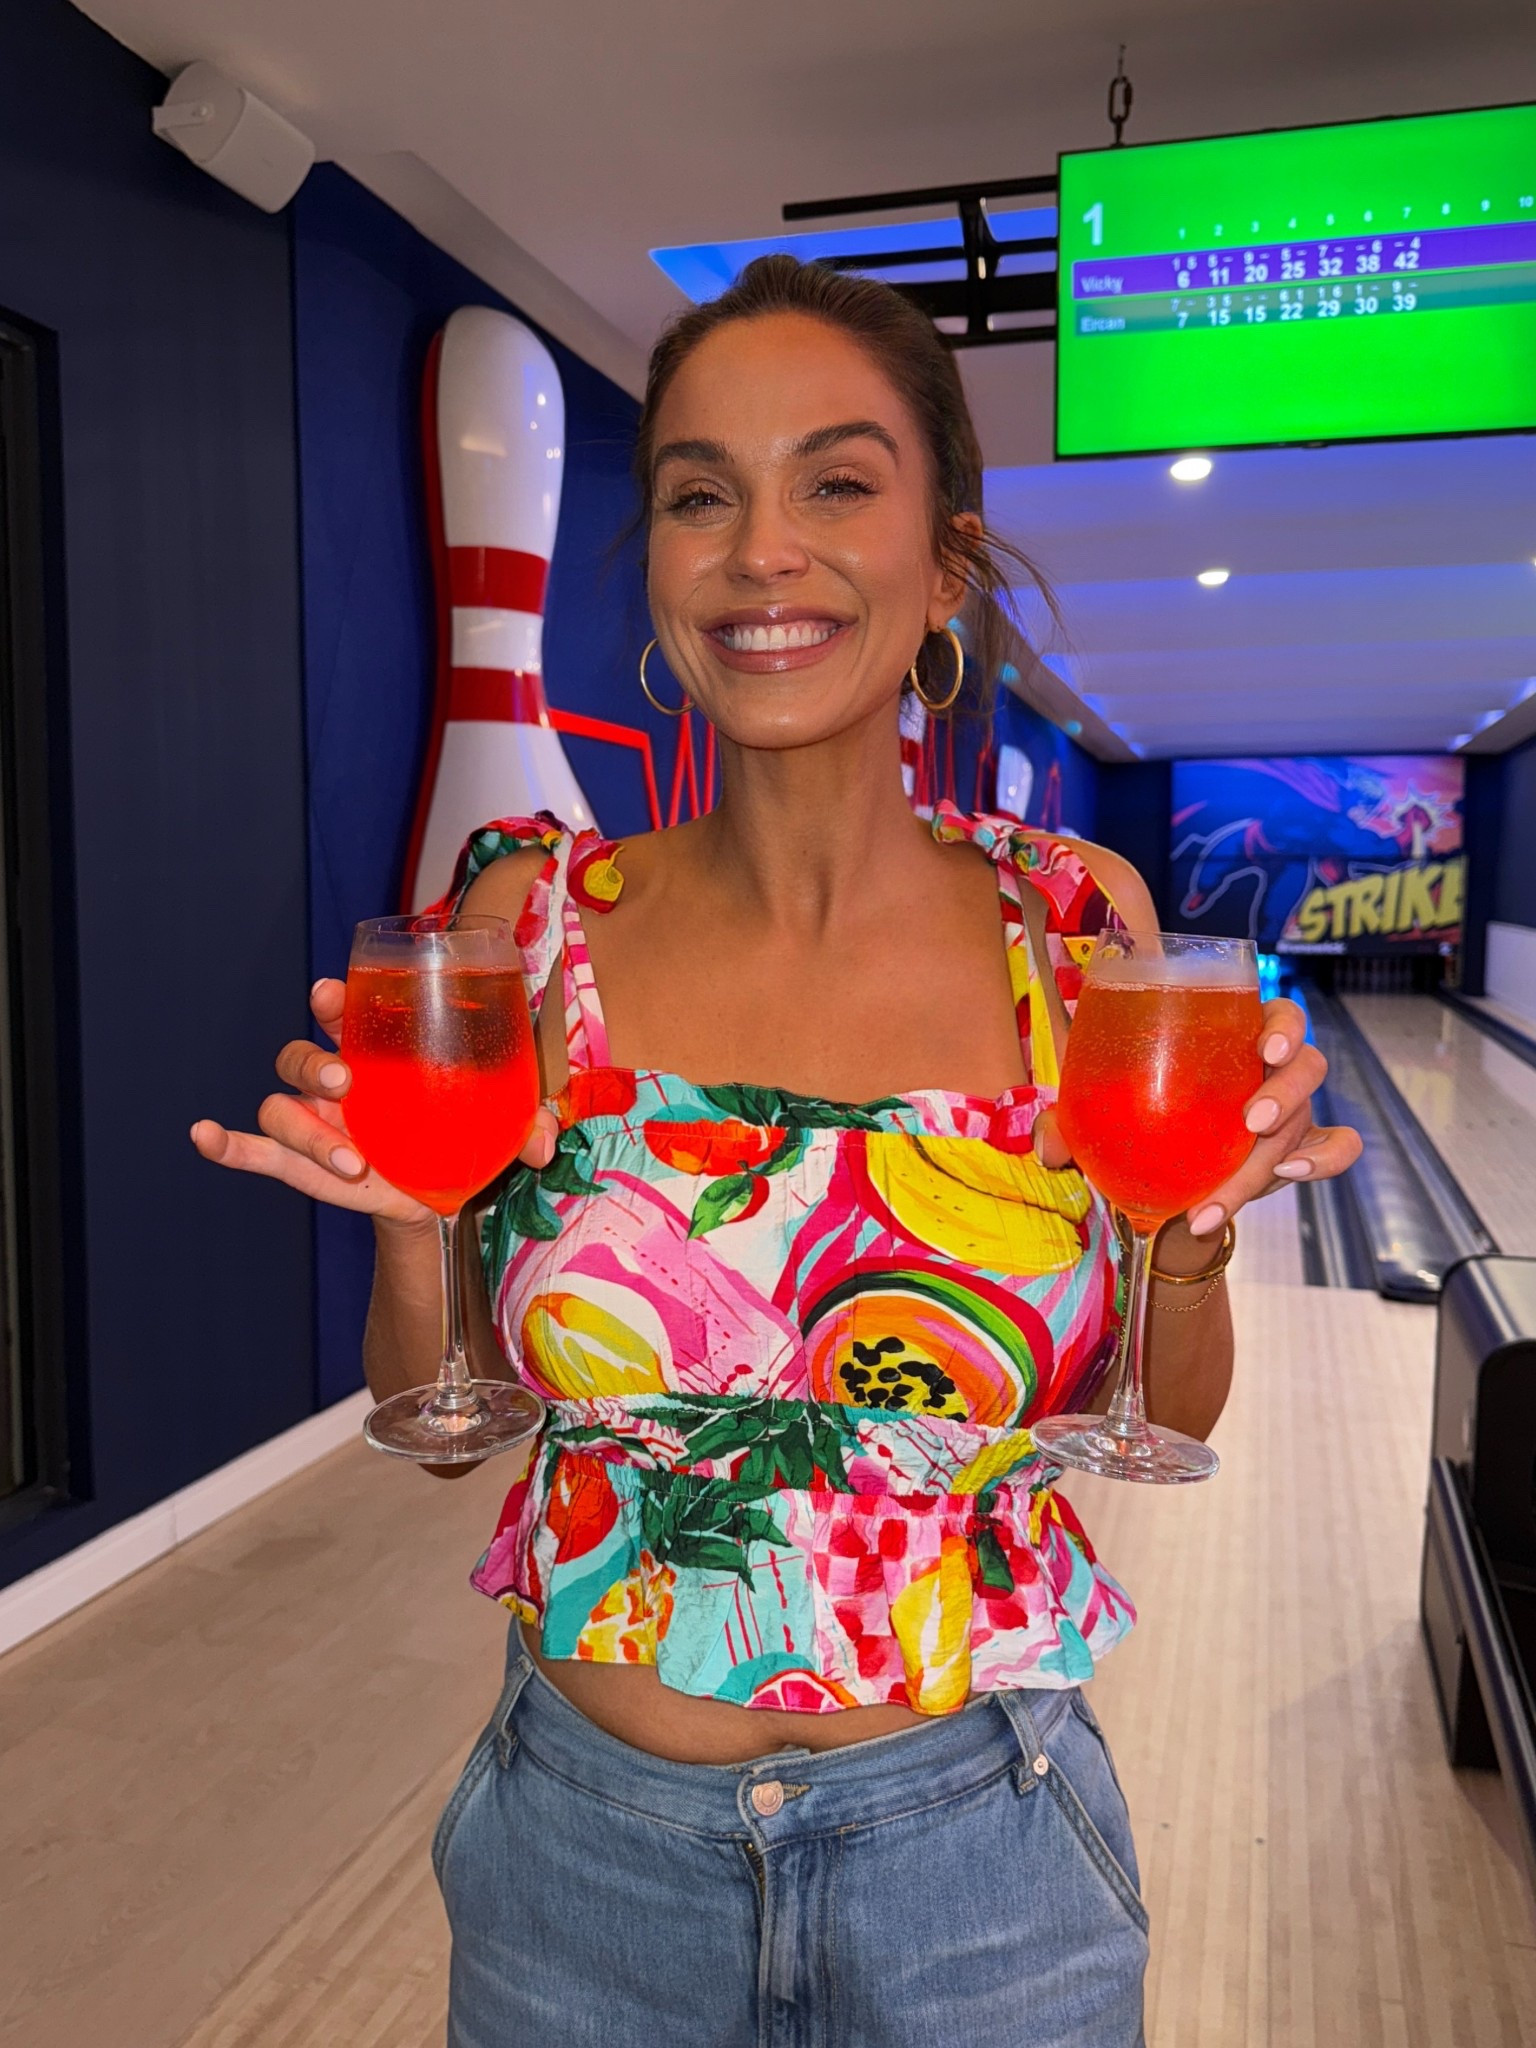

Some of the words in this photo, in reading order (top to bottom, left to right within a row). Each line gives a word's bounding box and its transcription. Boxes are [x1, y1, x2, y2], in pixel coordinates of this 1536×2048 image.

[1083, 201, 1103, 246] 1
[1179, 228, 1186, 240] 1
[1214, 224, 1223, 236] 2
[1251, 221, 1259, 232] 3
[1288, 217, 1296, 228] 4
[1403, 206, 1411, 218] 7
[1442, 203, 1450, 215] 8
[1481, 199, 1490, 211] 9
[1519, 196, 1534, 207] 10
[1080, 276, 1124, 294] Vicky
[1177, 270, 1190, 289] 6
[1209, 267, 1229, 285] 11
[1244, 264, 1268, 283] 20
[1281, 261, 1305, 280] 25
[1318, 257, 1343, 276] 32
[1356, 254, 1380, 273] 38
[1393, 251, 1419, 269] 42
[1178, 312, 1189, 328] 7
[1209, 310, 1230, 326] 15
[1244, 306, 1267, 323] 15
[1280, 303, 1304, 320] 22
[1317, 300, 1341, 317] 29
[1354, 296, 1378, 314] 30
[1392, 293, 1416, 311] 39
